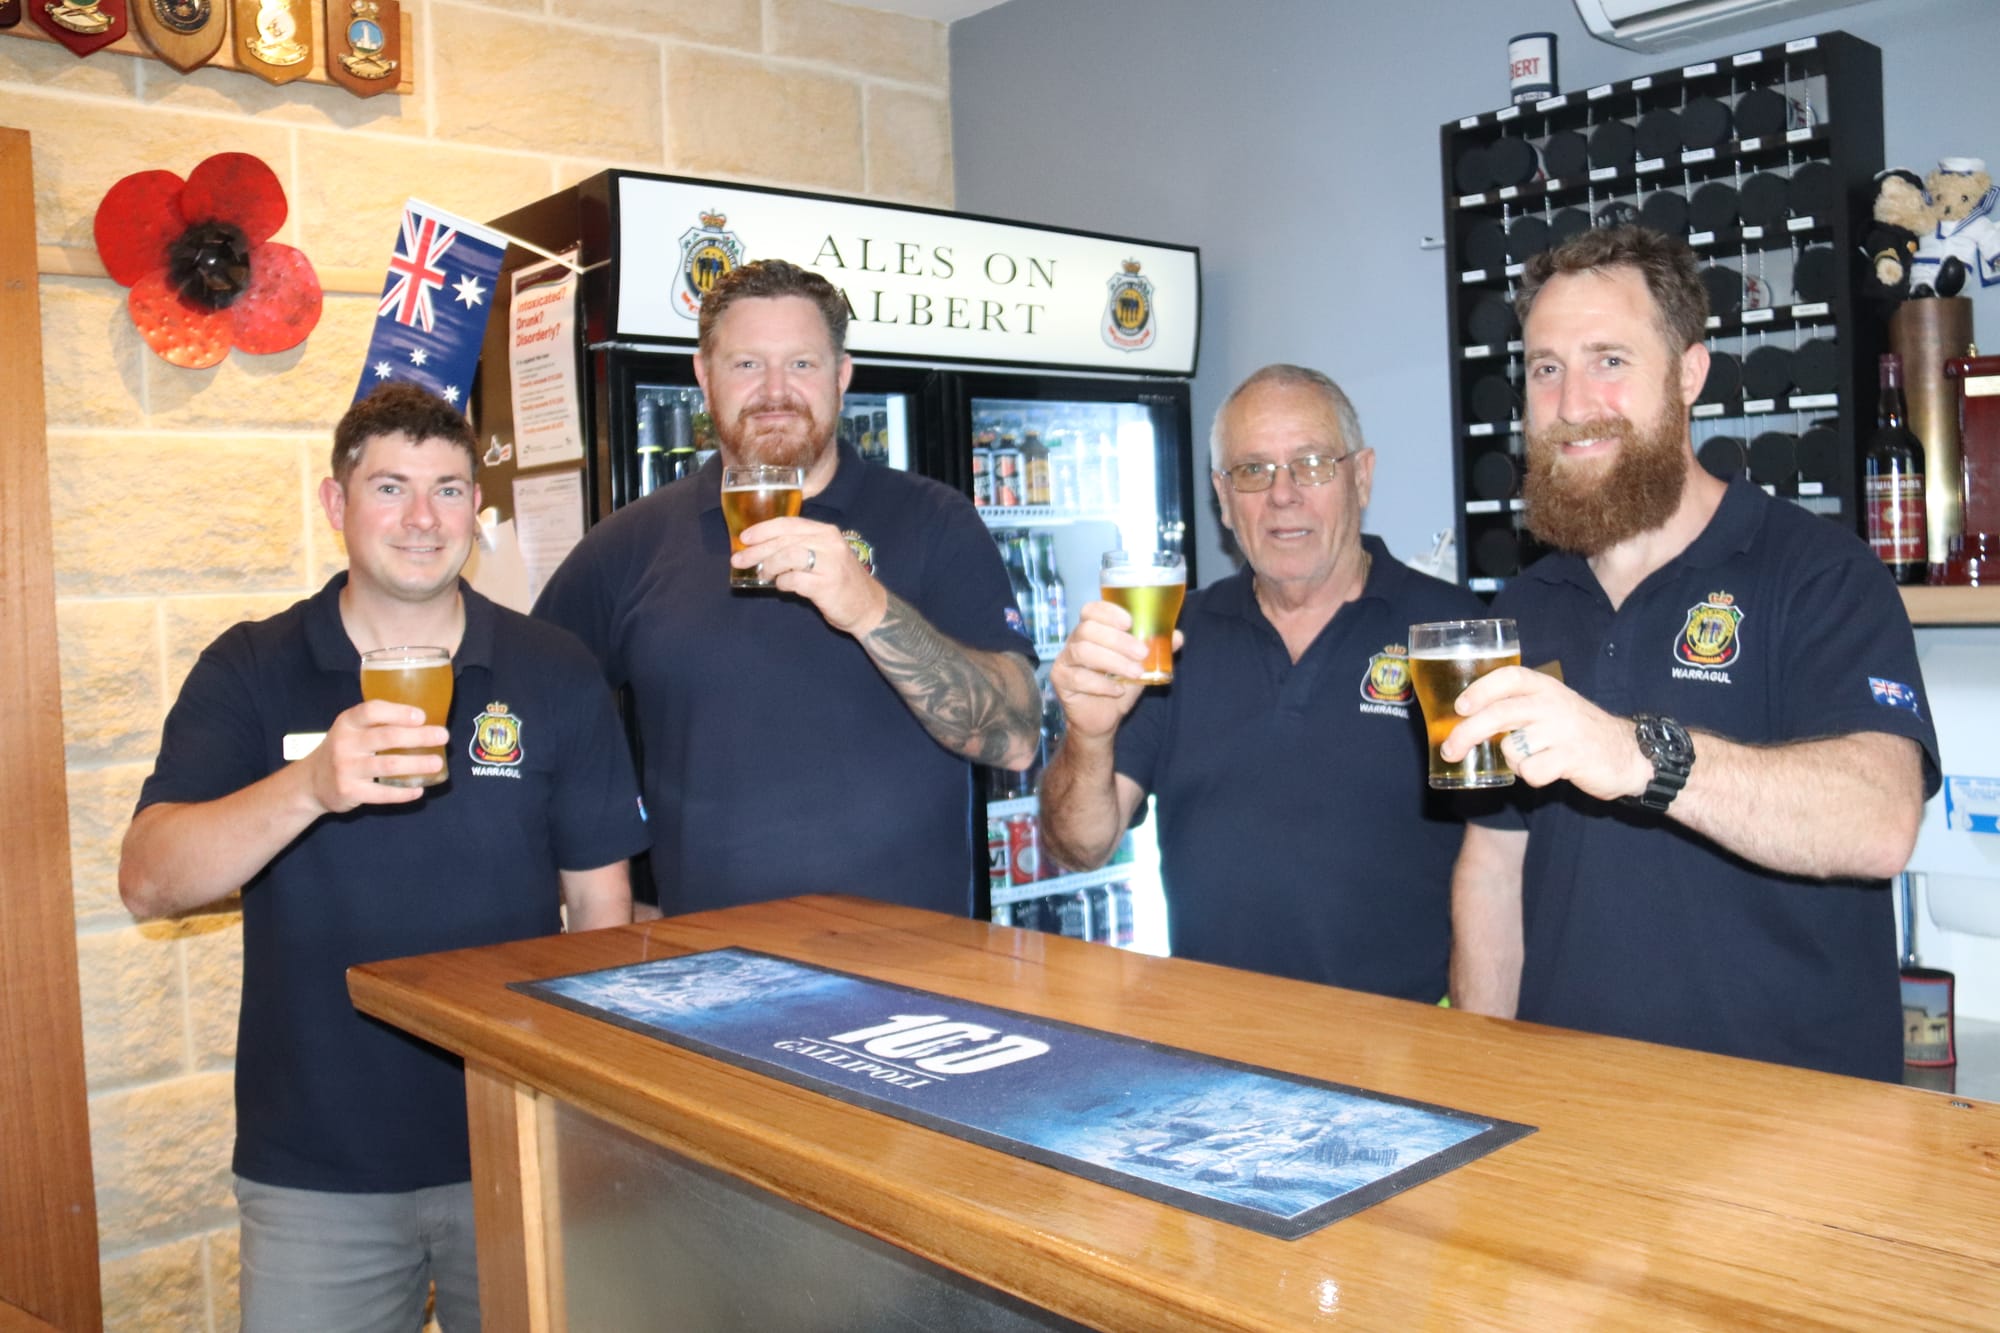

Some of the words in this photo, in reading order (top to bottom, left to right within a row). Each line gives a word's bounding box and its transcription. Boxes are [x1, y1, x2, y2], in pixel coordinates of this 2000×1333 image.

[811, 234, 954, 280] ALES
[983, 252, 1057, 289] ON
[517, 286, 567, 313] Intoxicated?
[516, 310, 544, 331] Drunk?
[516, 322, 561, 348] Disorderly?
[1672, 667, 1732, 684] WARRAGUL
[1360, 703, 1409, 719] WARRAGUL
[471, 766, 521, 779] WARRAGUL
[773, 1040, 932, 1090] GALLIPOLI
